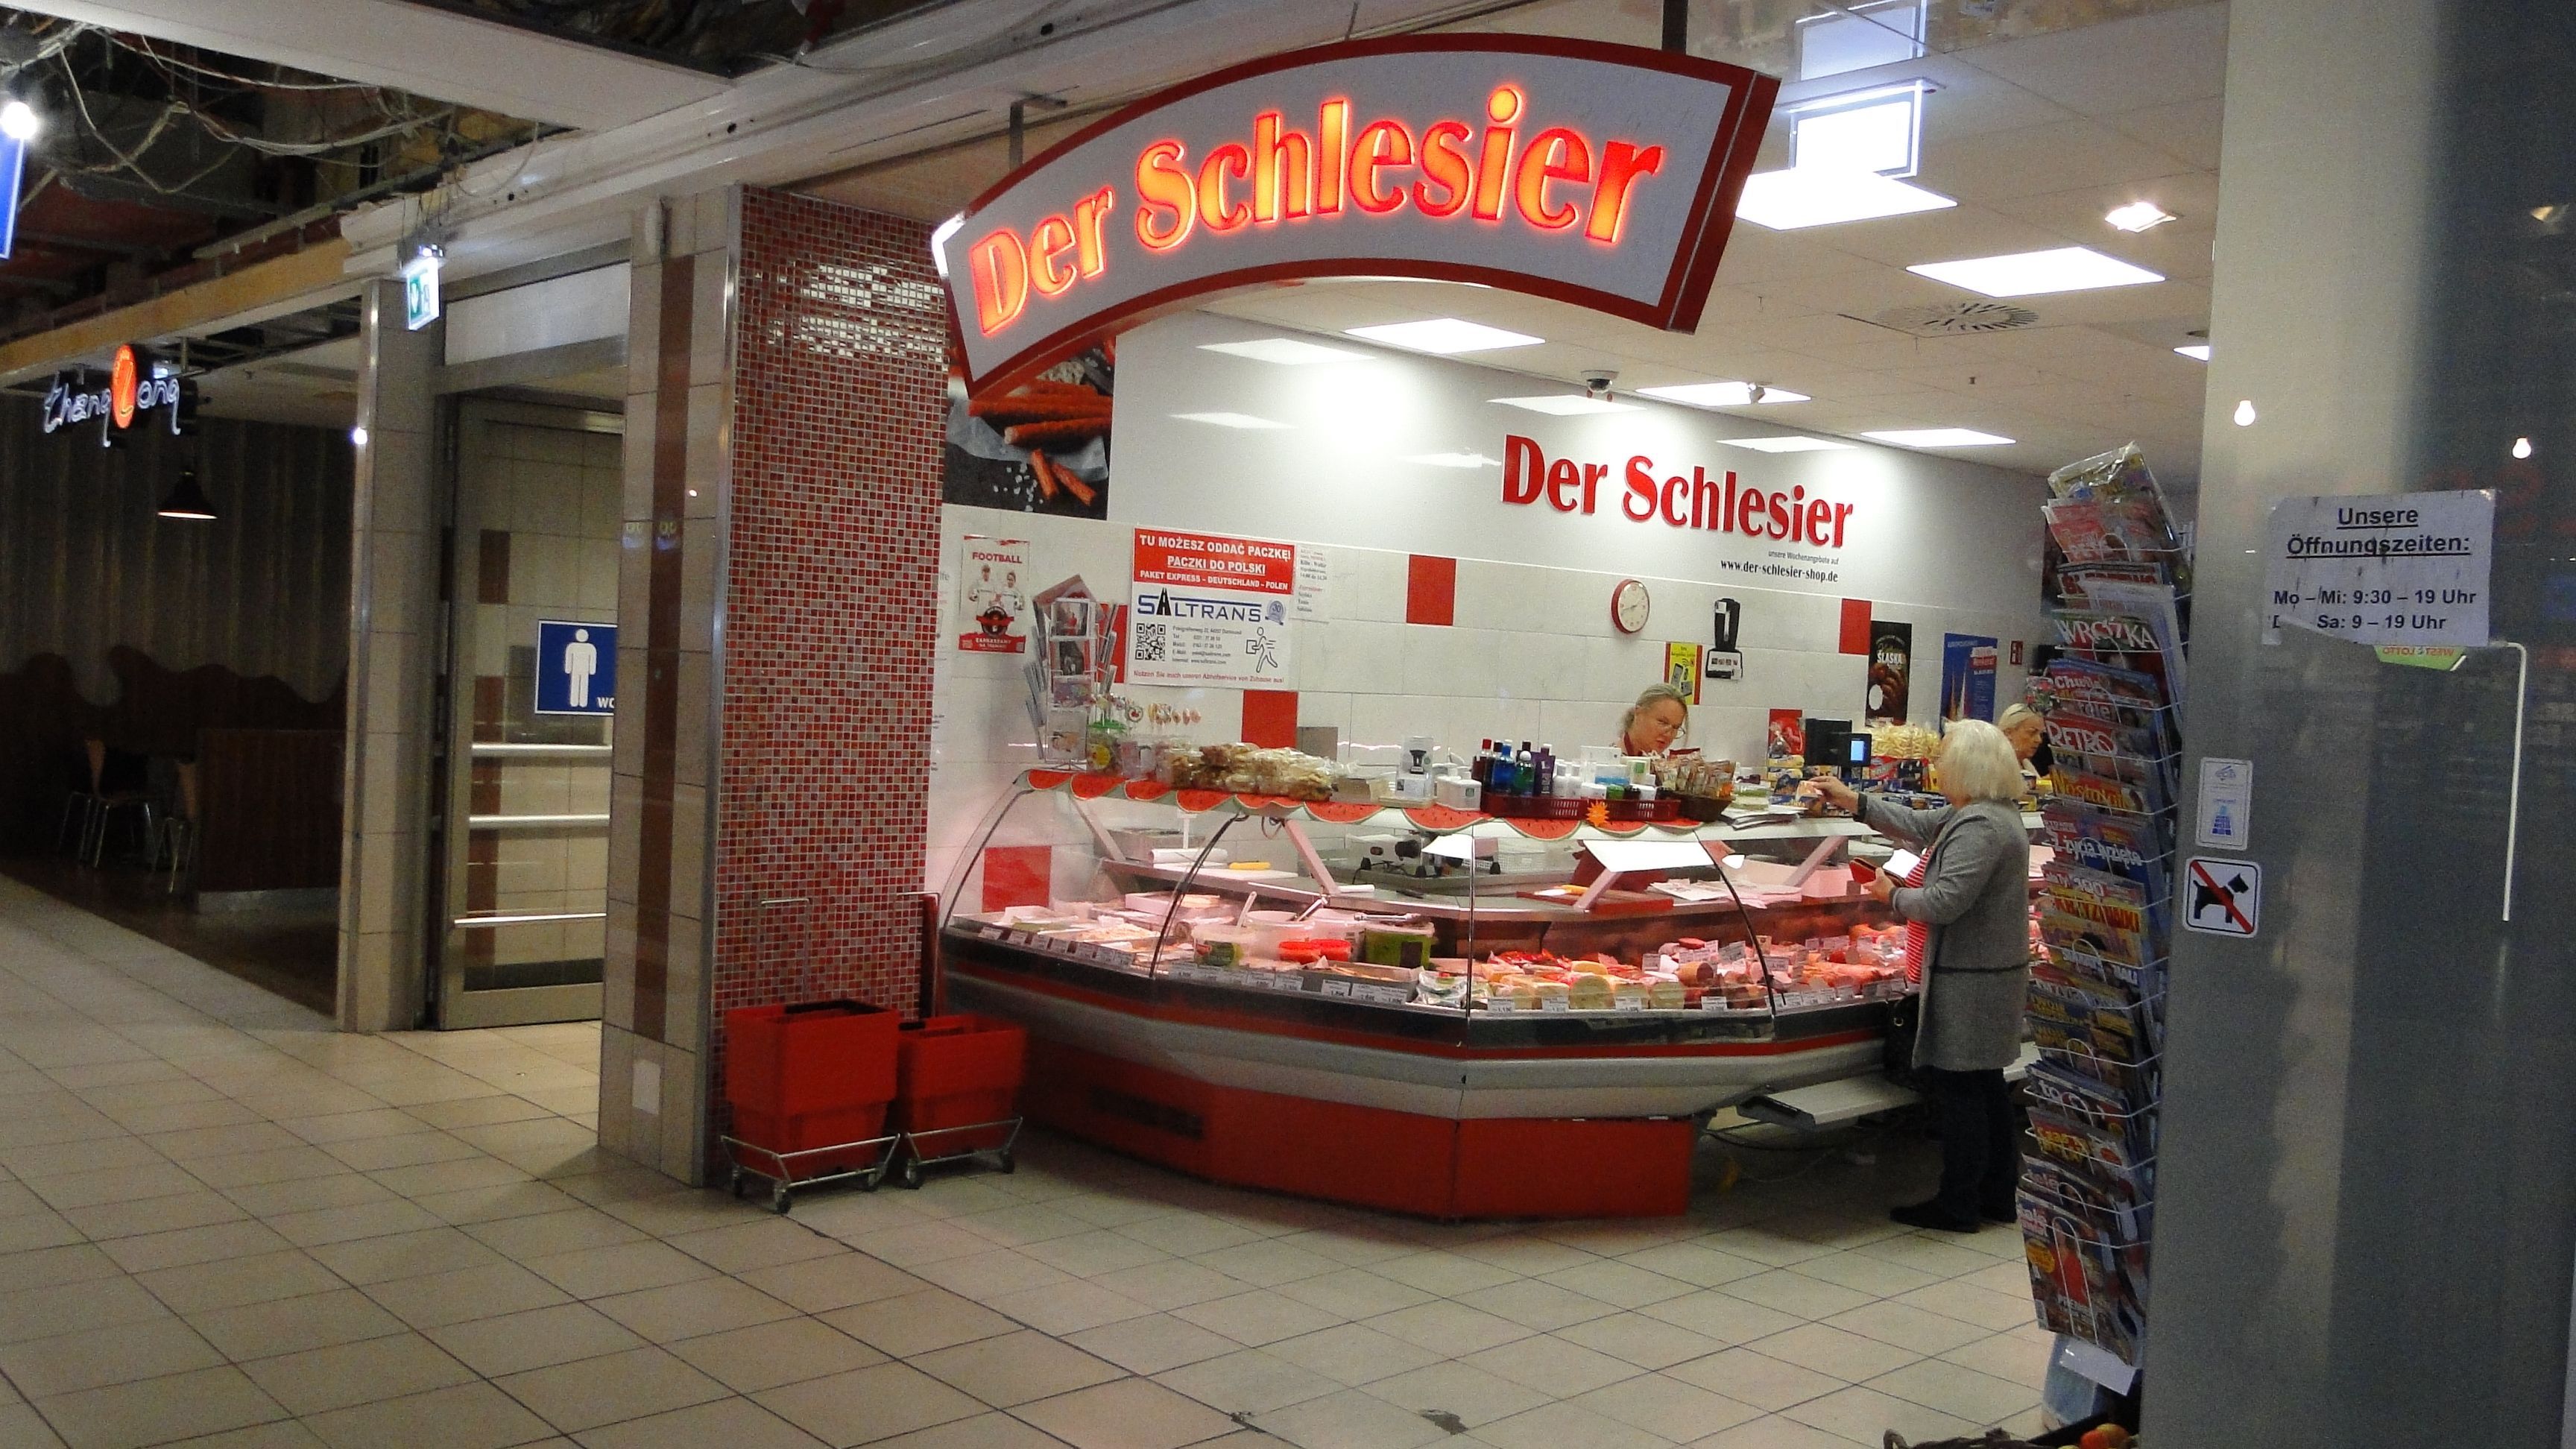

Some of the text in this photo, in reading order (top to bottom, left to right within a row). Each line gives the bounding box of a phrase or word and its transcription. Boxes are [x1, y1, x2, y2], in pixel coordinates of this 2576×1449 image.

[969, 86, 1663, 338] Der Schlesier
[1501, 434, 1854, 548] Der Schlesier
[2337, 507, 2419, 525] Unsere
[1140, 534, 1292, 563] TU MOŻESZ ODDAĆ PACZKĘ!
[1768, 550, 1787, 559] unsere
[2286, 534, 2470, 555] Öffnungszeiten:
[972, 552, 1023, 564] FOOTBALL
[1167, 555, 1266, 575] PACZKI DO POLSKI
[1140, 569, 1165, 580] PAKET
[1167, 572, 1201, 583] EXPRESS
[1208, 576, 1260, 588] DEUTSCHLAND
[1266, 581, 1288, 591] POLEN
[1720, 560, 1839, 584] www.der-schlesier-shop.de
[1137, 587, 1262, 623] SALTRANS
[2273, 590, 2300, 604] Mo
[2321, 590, 2347, 604] Mi:
[2352, 590, 2391, 604] 9:30
[2414, 590, 2435, 604] 19
[2443, 589, 2477, 604] Uhr
[2317, 614, 2346, 628] Sa:
[2352, 614, 2362, 628] 9
[2386, 614, 2405, 628] 19
[2411, 614, 2446, 629] Uhr
[2045, 720, 2118, 755] RETRO
